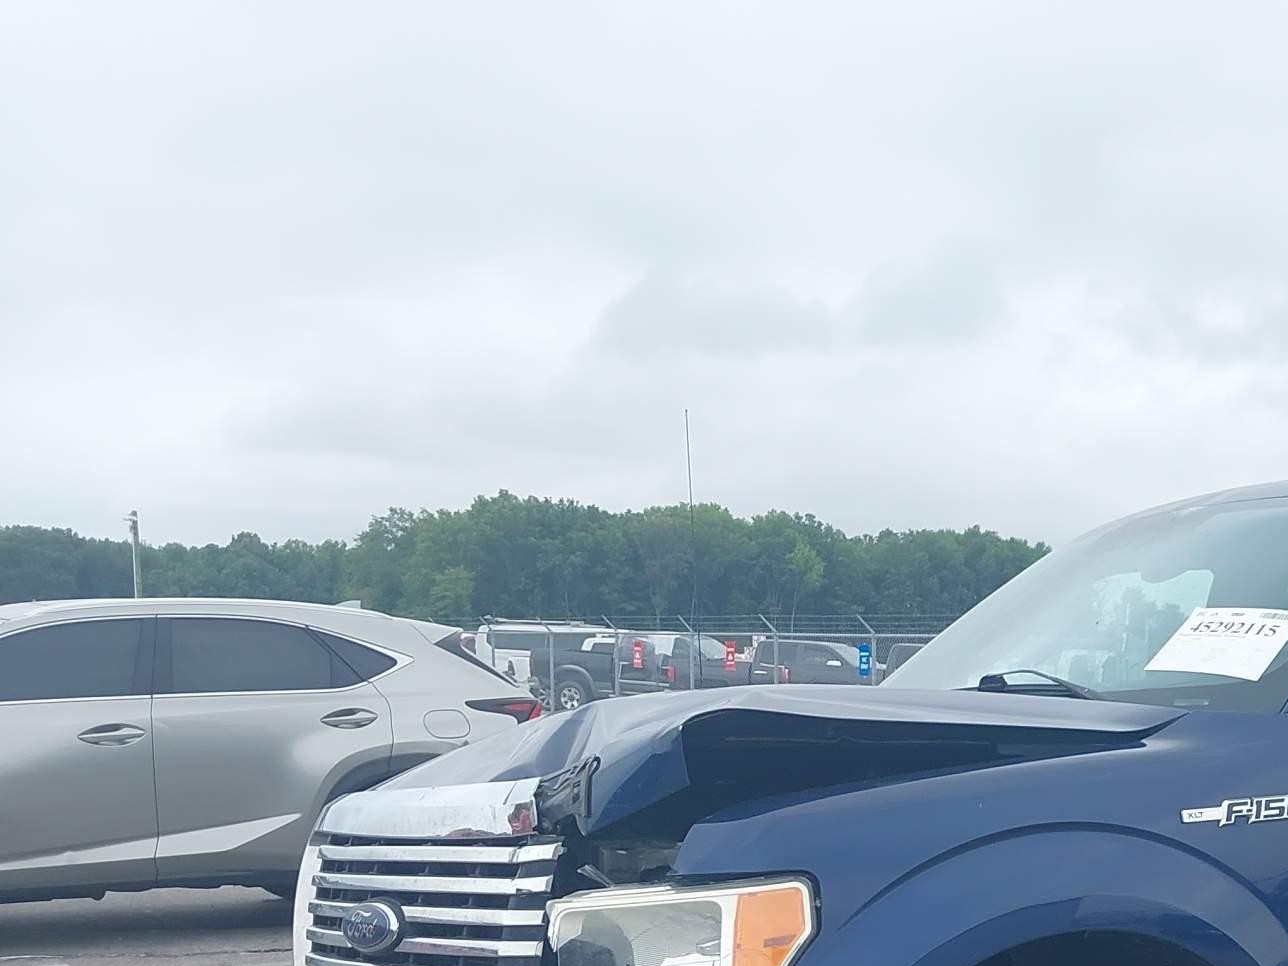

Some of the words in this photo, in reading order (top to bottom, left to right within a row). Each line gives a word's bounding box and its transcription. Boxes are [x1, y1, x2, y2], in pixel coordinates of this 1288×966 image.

[1190, 621, 1281, 637] 45292115
[1187, 811, 1205, 820] XLT
[347, 910, 378, 939] Ford
